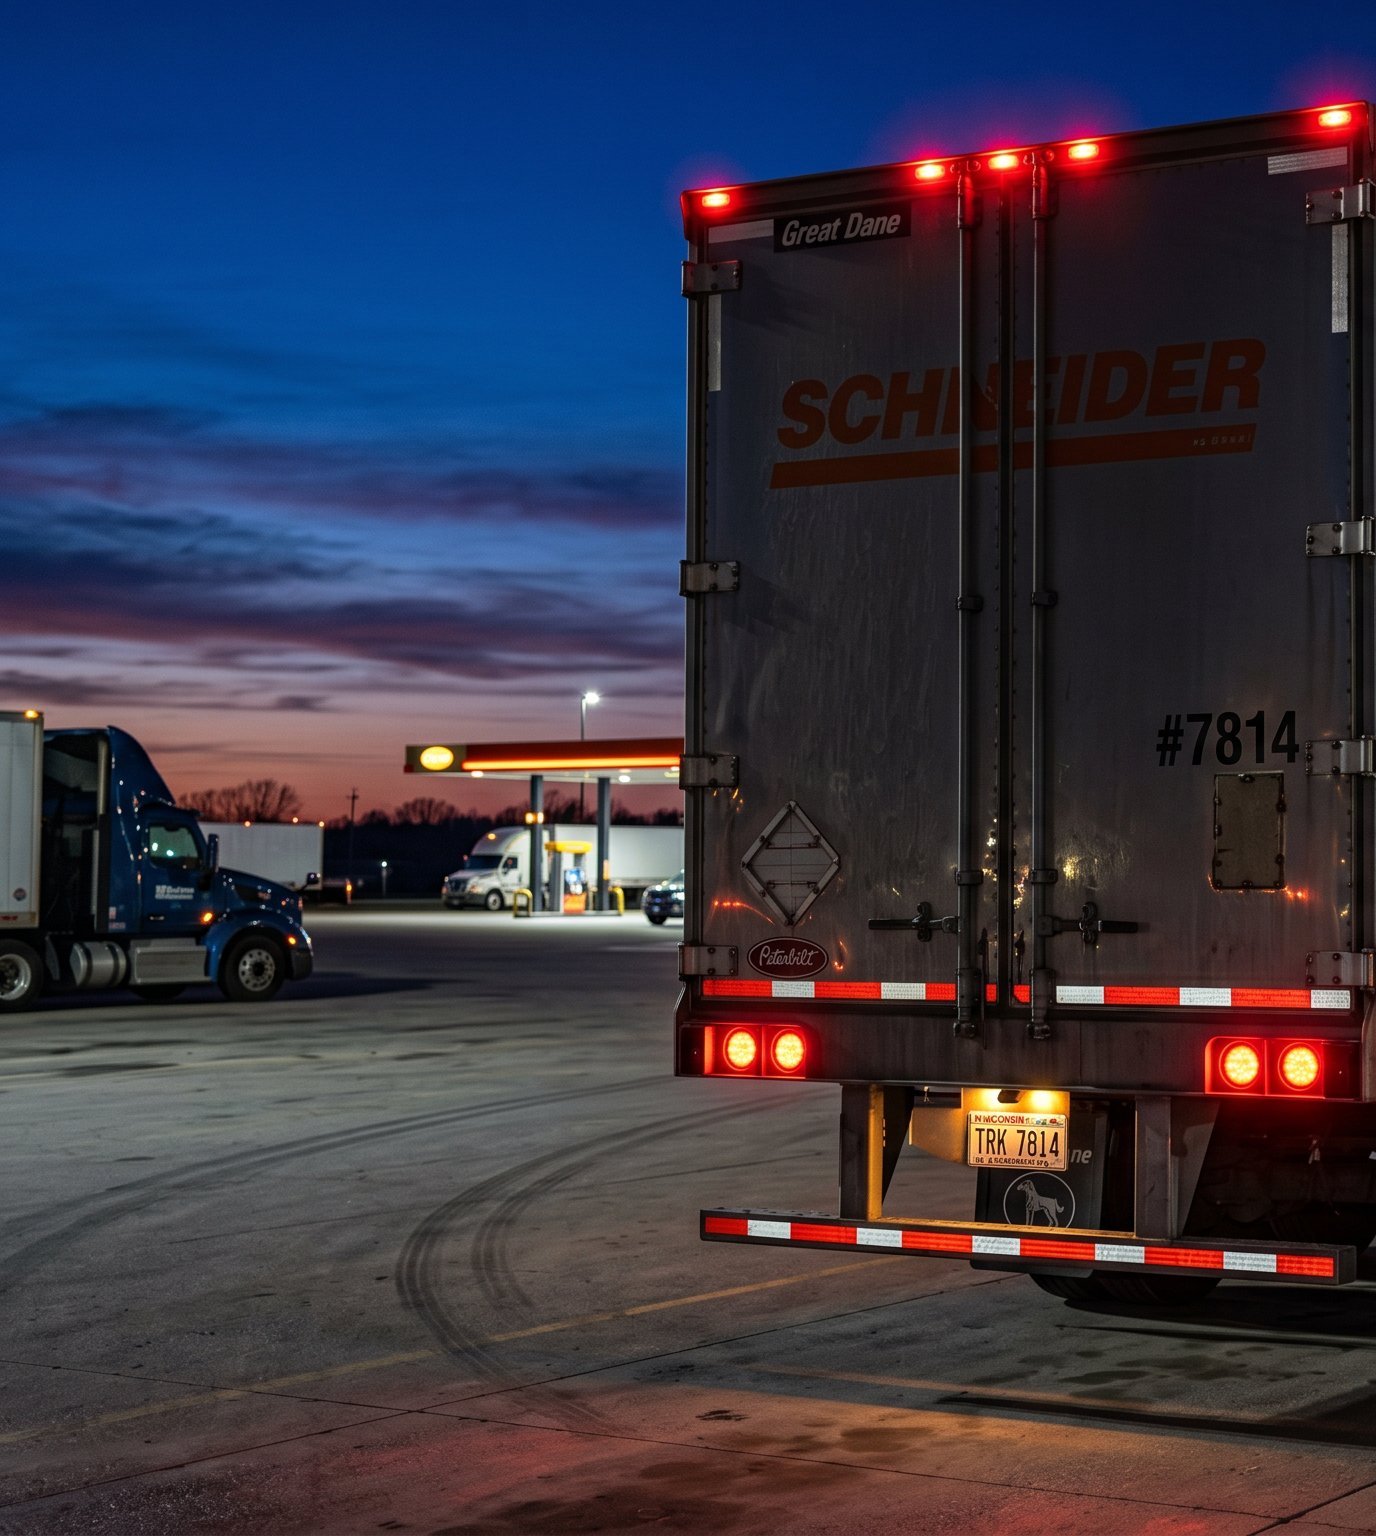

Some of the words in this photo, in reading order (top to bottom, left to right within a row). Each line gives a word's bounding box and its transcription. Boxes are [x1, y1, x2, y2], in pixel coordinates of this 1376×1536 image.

[781, 216, 842, 247] Great
[843, 211, 902, 240] Dane
[776, 338, 1267, 449] SCHNEIDER
[1156, 710, 1300, 767] #7814
[758, 945, 819, 967] Peterbilt
[975, 1127, 1007, 1156] TRK
[1016, 1129, 1060, 1158] 7814
[1070, 1148, 1093, 1165] ne
